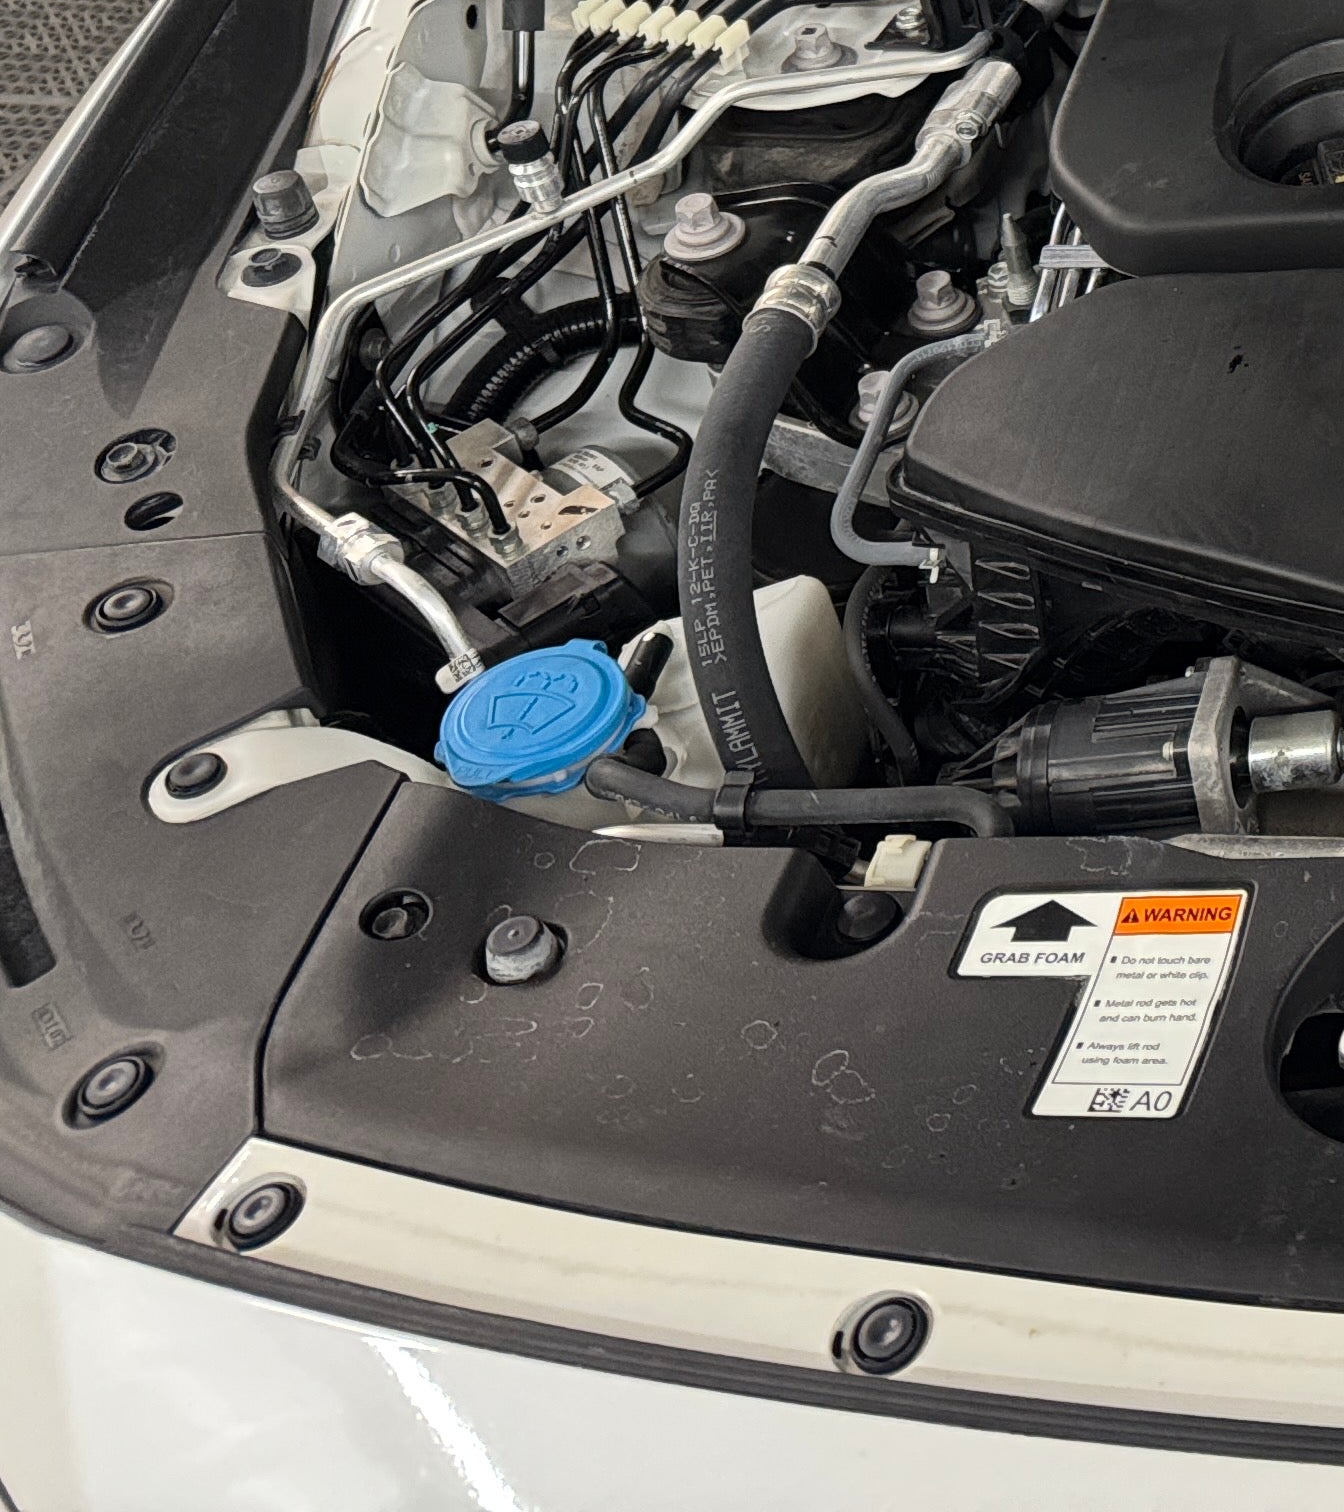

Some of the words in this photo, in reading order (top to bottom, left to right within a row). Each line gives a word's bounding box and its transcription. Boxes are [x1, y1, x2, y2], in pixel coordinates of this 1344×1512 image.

[1144, 906, 1232, 923] WARNING
[980, 952, 1030, 964] GRAB
[1034, 952, 1085, 964] FOAM
[1121, 956, 1135, 965] Do
[1137, 956, 1154, 965] not
[1157, 955, 1185, 965] touch
[1187, 955, 1211, 965] bare
[1116, 970, 1144, 980] metal
[1146, 972, 1157, 980] or
[1159, 970, 1187, 980] white
[1105, 999, 1133, 1008] Metal
[1136, 999, 1153, 1008] rod
[1155, 999, 1178, 1010] gets
[1180, 998, 1197, 1007] hot
[1099, 1014, 1120, 1023] and
[1122, 1015, 1141, 1023] can
[1143, 1013, 1166, 1023] burn
[1169, 1012, 1197, 1022] hand.
[1087, 1042, 1125, 1053] Always
[1127, 1042, 1141, 1051] lift
[1142, 1042, 1160, 1052] rod
[1082, 1056, 1110, 1066] using
[1113, 1055, 1139, 1065] foam
[1141, 1057, 1168, 1065] area.
[1129, 1090, 1173, 1112] A0
